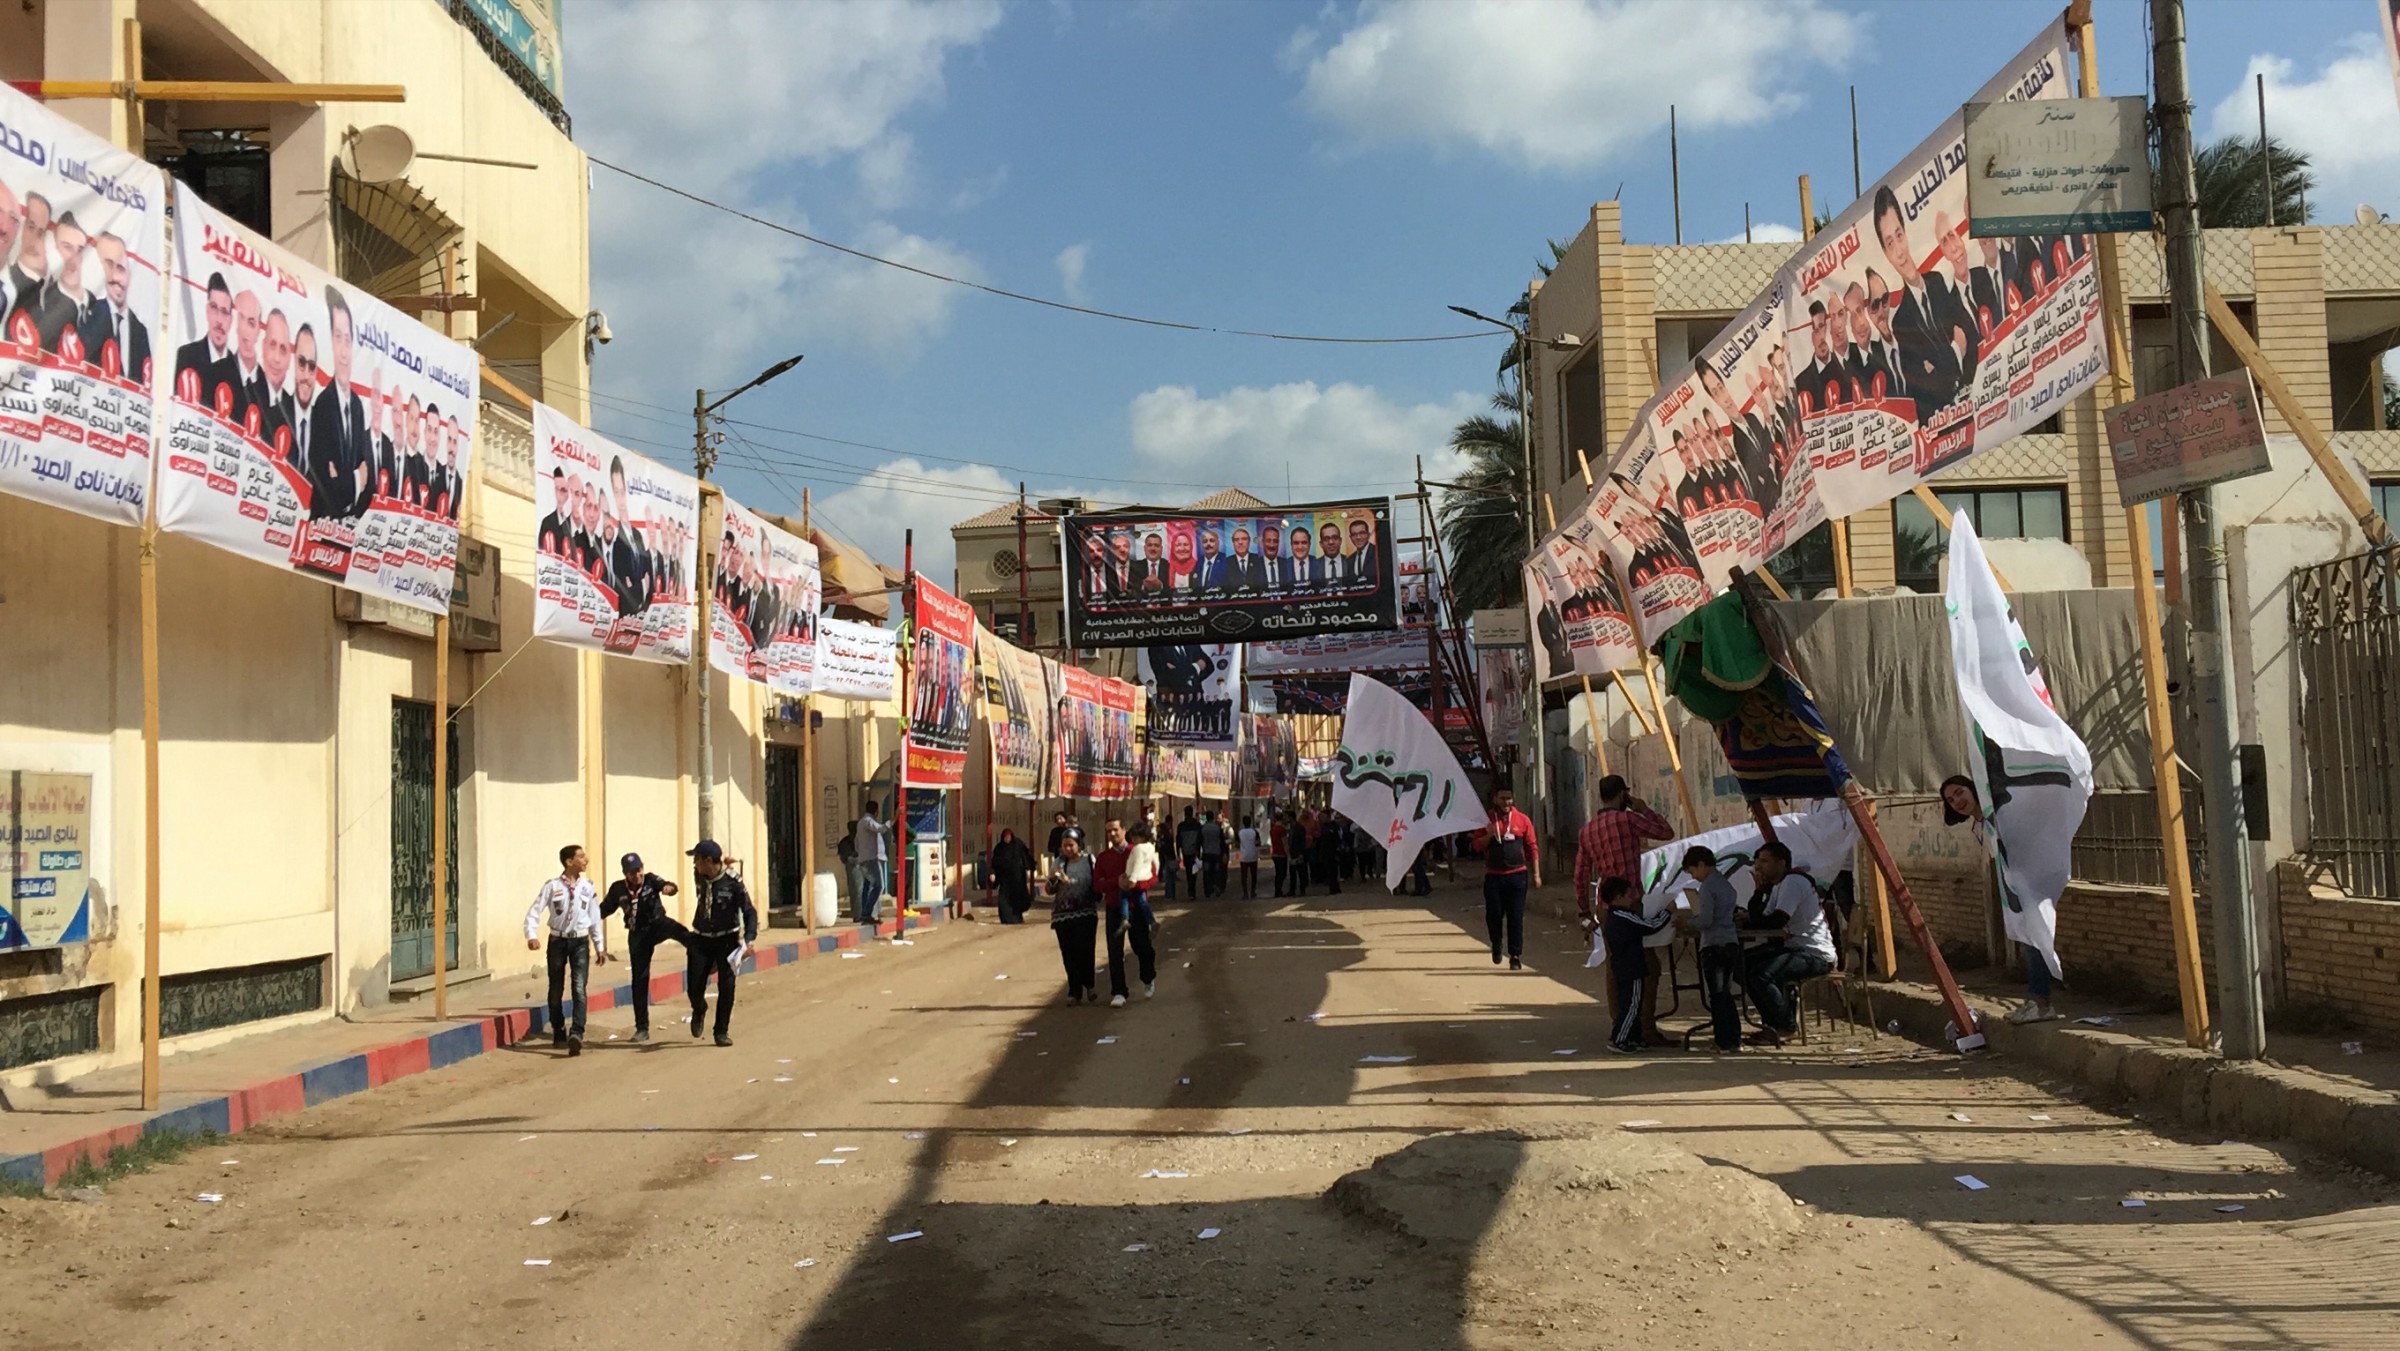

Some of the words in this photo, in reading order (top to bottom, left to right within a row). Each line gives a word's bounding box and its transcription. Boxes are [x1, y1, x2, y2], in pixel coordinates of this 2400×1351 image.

[2036, 106, 2076, 126] سنتر
[2032, 166, 2059, 179] منزلية
[2060, 164, 2085, 177] أدوات
[1838, 223, 1862, 271] نعم
[1800, 247, 1838, 298] للتغيير
[2056, 290, 2077, 318] أحمد
[2033, 310, 2052, 336] ياسر
[1738, 323, 1759, 352] محمد
[390, 342, 424, 375] محمد
[2007, 338, 2028, 364] على
[2008, 352, 2030, 382] نسيم
[1982, 367, 2002, 390] يسرى
[2056, 367, 2078, 398] نادى
[50, 376, 82, 402] ياسر
[1679, 380, 1695, 410] نعم
[2030, 378, 2055, 413] الصيد
[0, 396, 38, 416] نسي
[92, 394, 121, 417] أحمد
[1656, 390, 1681, 428] للتغيير
[2157, 396, 2194, 430] فرسان
[2196, 389, 2232, 418] جمعية
[169, 419, 210, 439] مصطفى
[1828, 421, 1854, 439] مسعد
[1863, 416, 1886, 440] أكرم
[1890, 422, 1909, 439] محمد
[2120, 405, 2154, 437] الحياة
[1829, 433, 1855, 453] الزرقا
[1933, 426, 1967, 459] الرئيس
[2146, 417, 2225, 456] للمكفوفين
[214, 440, 240, 459] مسعد
[31, 454, 72, 482] الصيد
[75, 470, 105, 492] نادى
[276, 495, 298, 512] محمد
[1690, 520, 1714, 539] مصطفى
[309, 548, 344, 568] الرئيس
[1299, 602, 1322, 611] الدكتور
[1322, 601, 1340, 609] قائمة
[1086, 617, 1113, 627] جماعية
[1151, 614, 1179, 625] حقيقية
[1179, 612, 1200, 622] تنمية
[1262, 610, 1317, 629] شحاته
[1320, 612, 1378, 628] محمود
[1082, 631, 1101, 641] ٢٠١٧
[1102, 629, 1134, 640] الصيد
[1135, 627, 1160, 640] نادى
[24, 825, 52, 843] الصيد
[53, 826, 79, 844] بنادى
[42, 853, 65, 870] طاولة
